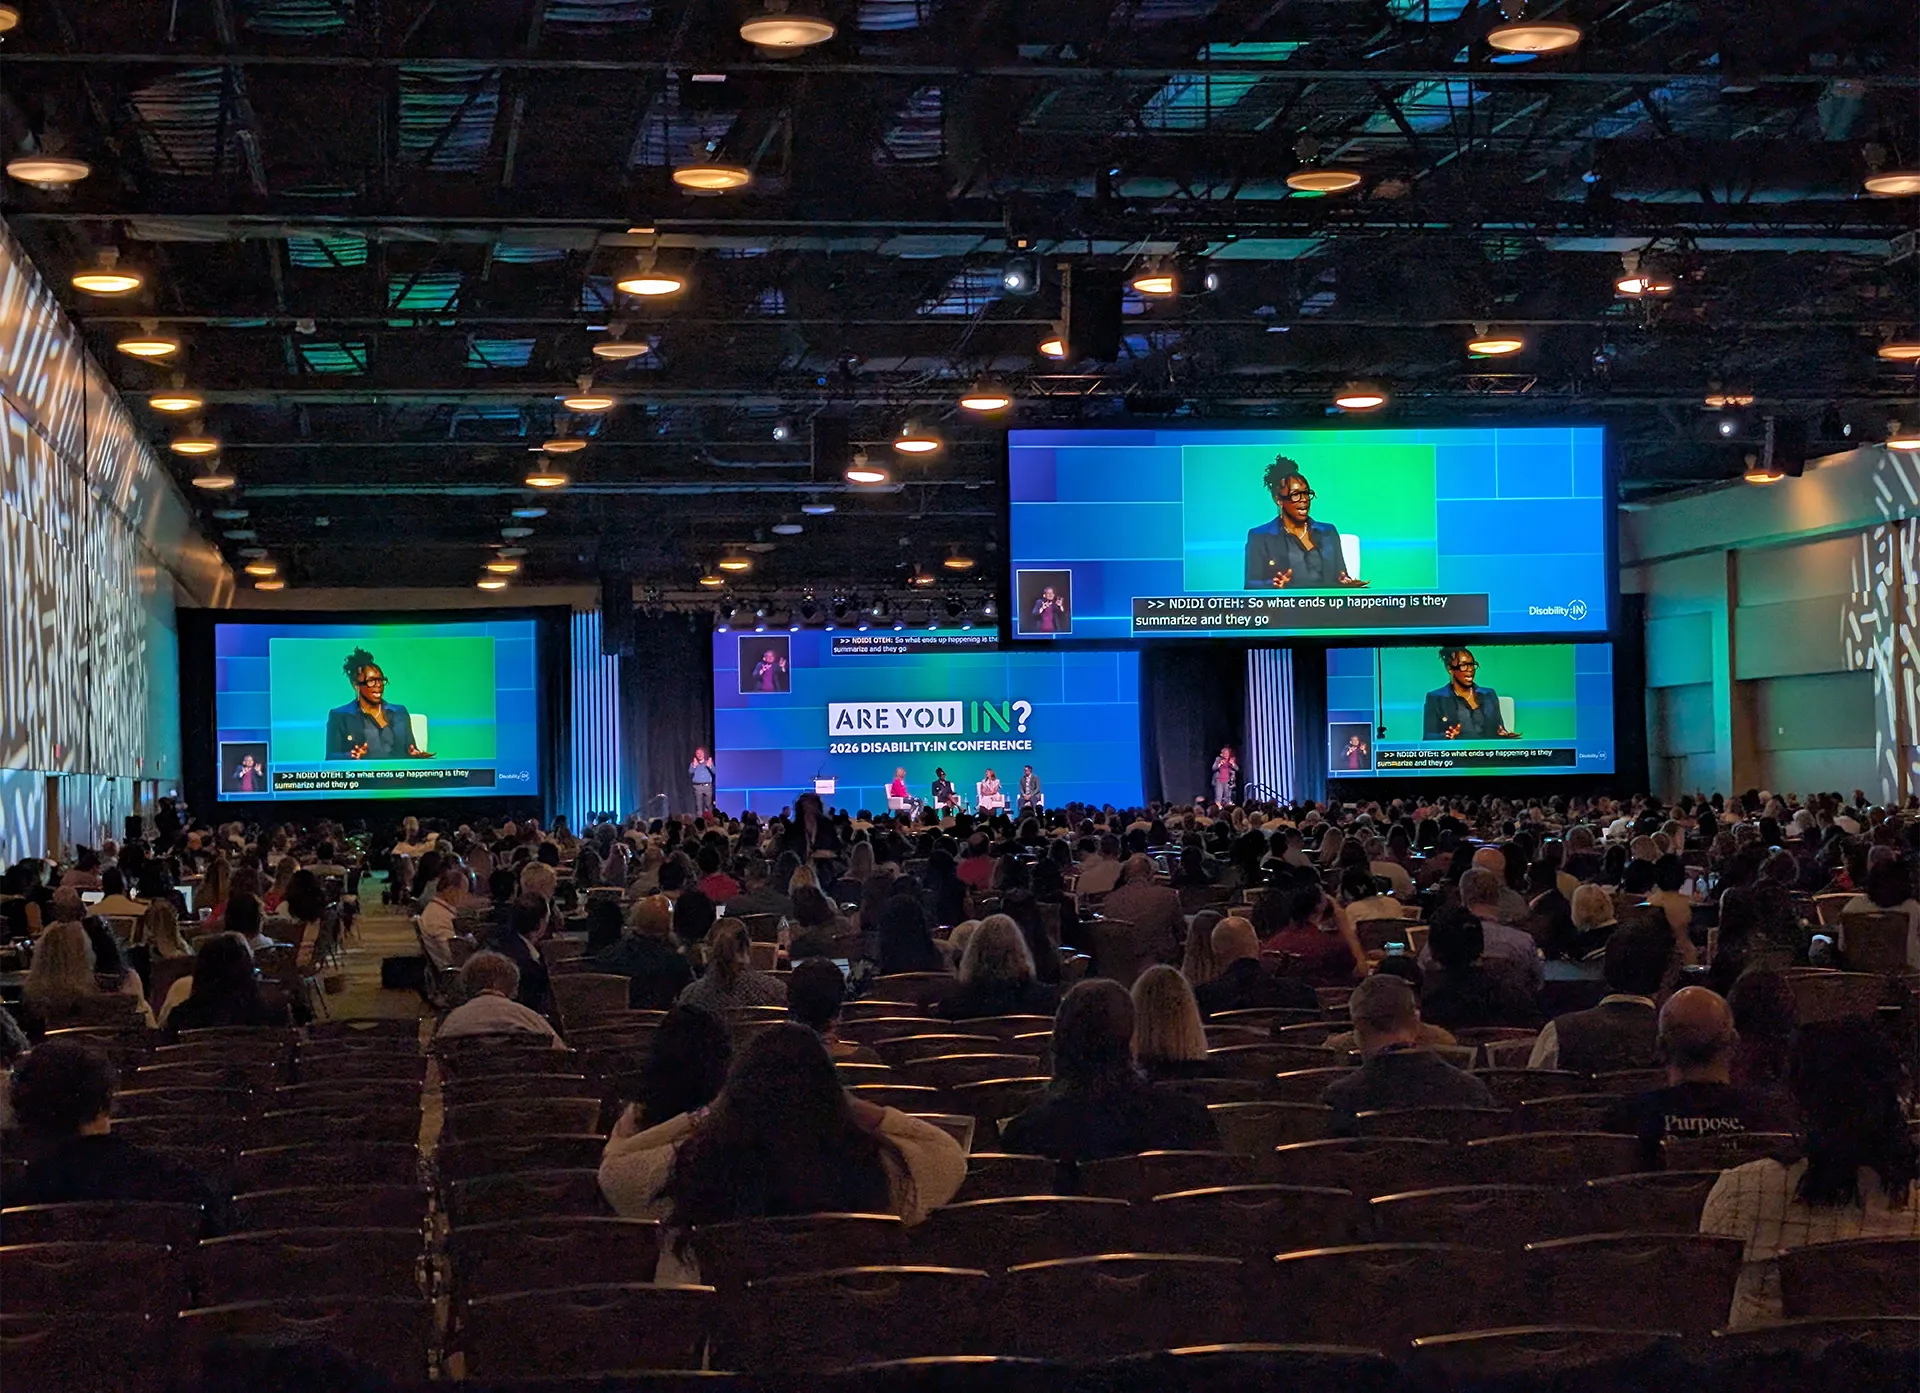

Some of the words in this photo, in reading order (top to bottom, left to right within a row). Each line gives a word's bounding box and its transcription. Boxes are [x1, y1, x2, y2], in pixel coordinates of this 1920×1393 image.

[1169, 598, 1204, 609] NDIDI
[1207, 597, 1245, 609] OTEH:
[1248, 597, 1264, 608] So
[1267, 597, 1296, 608] what
[1298, 596, 1326, 607] ends
[1329, 598, 1344, 609] up
[1347, 596, 1406, 608] happening
[1409, 596, 1420, 606] is
[1422, 595, 1448, 607] they
[1135, 614, 1198, 626] summarize
[1200, 613, 1222, 625] and
[1225, 614, 1251, 627] they
[1254, 615, 1269, 626] go
[905, 635, 921, 643] what
[938, 636, 947, 645] up
[948, 634, 980, 644] happening
[988, 634, 998, 642] the
[833, 645, 868, 653] summarize
[869, 645, 882, 653] and
[883, 645, 898, 654] they
[836, 708, 890, 730] ARE
[895, 707, 955, 729] YOU
[970, 700, 1032, 734] IN?
[830, 743, 859, 753] 2026
[861, 742, 947, 753] DISABILITY:IN
[949, 740, 1032, 751] CONFERENCE
[1451, 750, 1467, 758] what
[1530, 748, 1537, 756] is
[1537, 748, 1553, 757] they
[356, 770, 375, 778] what
[376, 770, 394, 778] ends
[406, 770, 444, 779] happening
[445, 769, 452, 777] is
[453, 768, 469, 778] they
[274, 781, 314, 789] summarize
[315, 780, 330, 788] and
[331, 780, 347, 789] they
[1663, 1114, 1745, 1134] Purpose.
